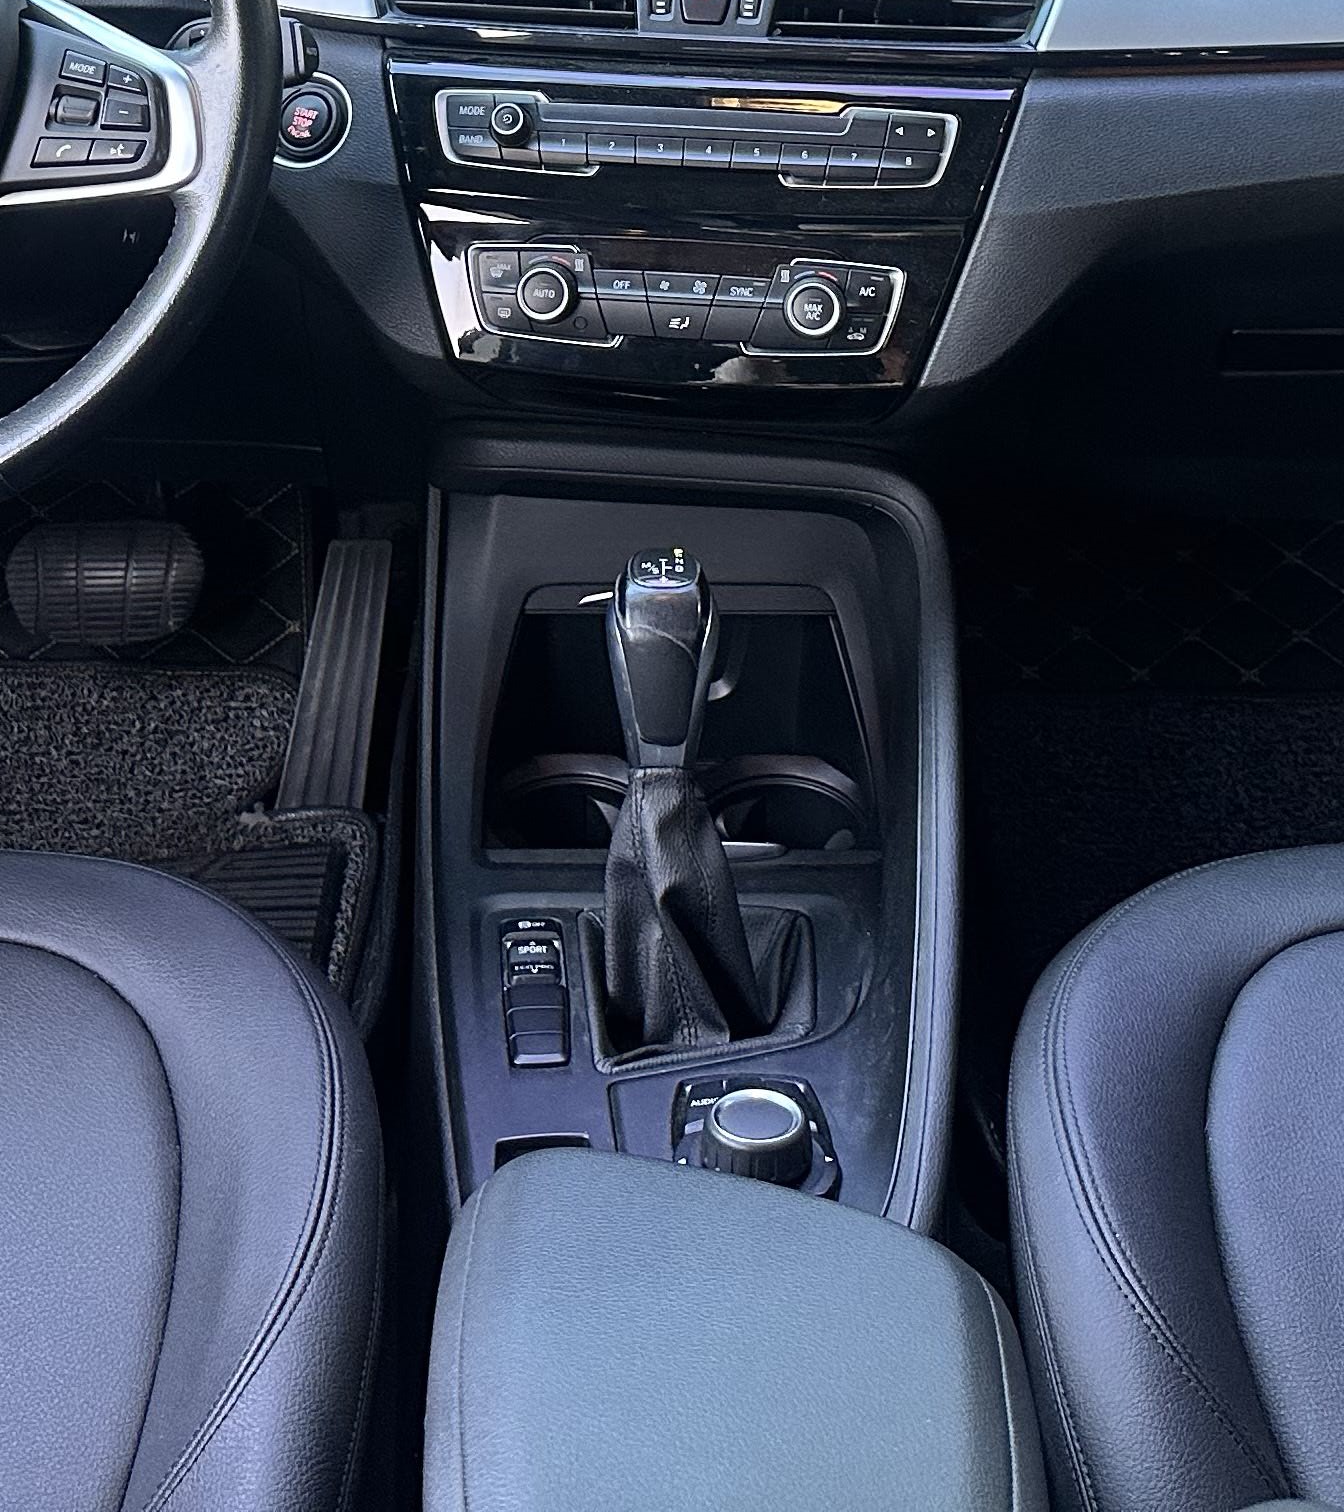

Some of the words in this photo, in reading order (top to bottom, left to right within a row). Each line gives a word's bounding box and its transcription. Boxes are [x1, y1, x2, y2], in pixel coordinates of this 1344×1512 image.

[69, 62, 96, 75] MODE
[294, 107, 318, 119] START
[459, 105, 486, 116] MODE
[293, 116, 313, 127] STOP
[459, 134, 484, 144] BAND
[560, 138, 565, 146] 1
[609, 141, 615, 151] 2
[657, 144, 664, 153] 3
[706, 145, 712, 154] 4
[753, 147, 760, 157] 5
[801, 150, 808, 160] 6
[851, 152, 858, 162] 7
[905, 157, 912, 166] 8
[613, 280, 631, 290] OFF
[533, 289, 555, 299] AUTO
[730, 287, 754, 297] SYNC
[859, 287, 876, 297] A/C
[804, 303, 823, 313] MAX
[806, 312, 821, 321] A/C
[518, 945, 547, 955] SPORT
